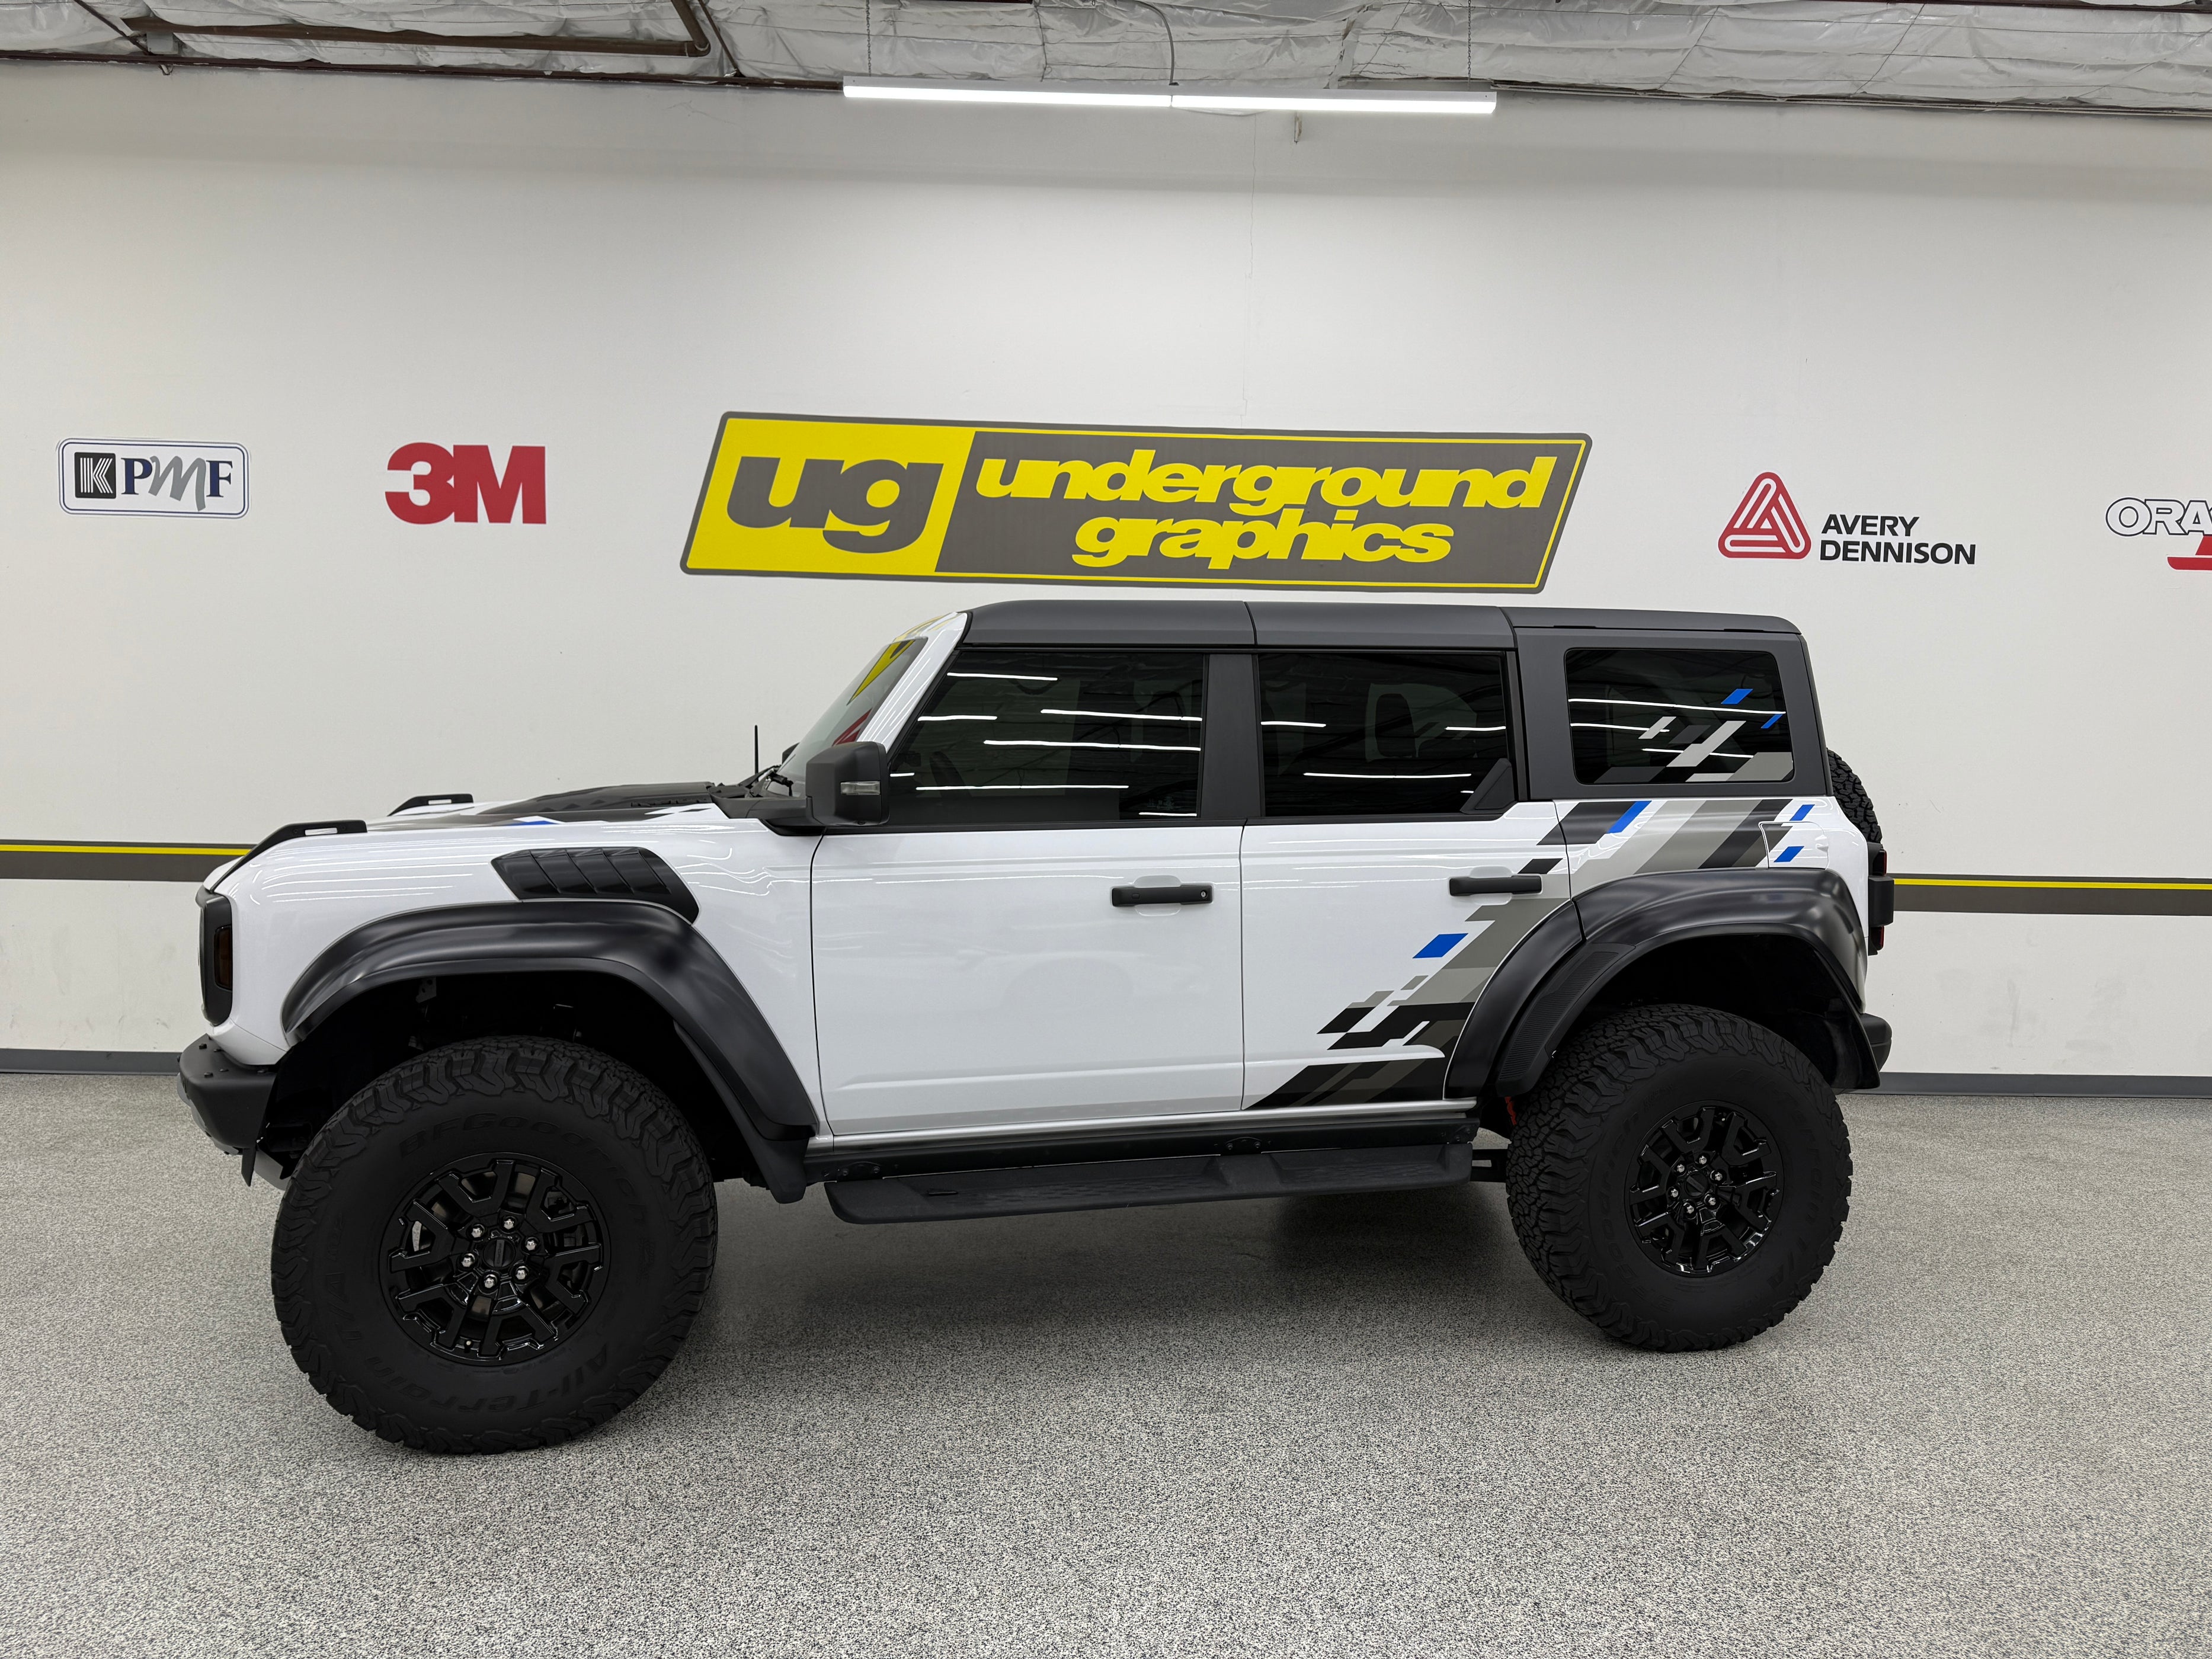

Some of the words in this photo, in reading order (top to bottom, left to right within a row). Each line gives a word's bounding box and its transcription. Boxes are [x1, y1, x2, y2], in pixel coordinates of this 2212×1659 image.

[386, 443, 546, 524] 3M
[727, 456, 945, 555] ug
[976, 449, 1558, 517] underground
[2105, 497, 2212, 537] ORA
[1072, 508, 1455, 570] graphics
[1820, 540, 1976, 565] DENNISON
[1822, 514, 1919, 537] AVERY
[399, 1112, 646, 1223] BFGoodrich
[365, 1343, 607, 1413] All-Terrain
